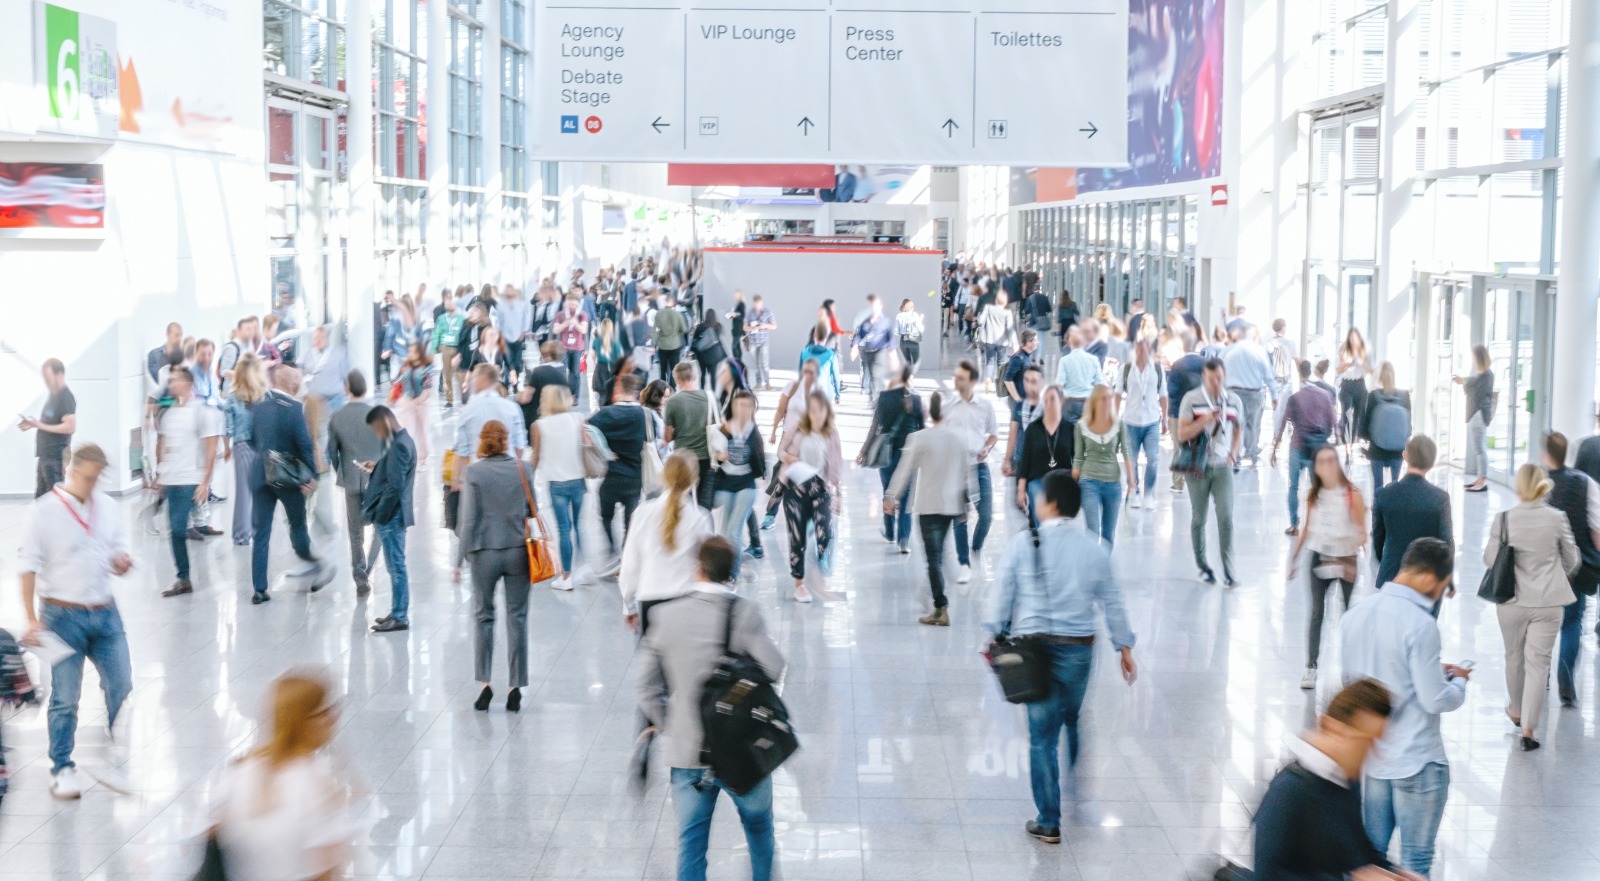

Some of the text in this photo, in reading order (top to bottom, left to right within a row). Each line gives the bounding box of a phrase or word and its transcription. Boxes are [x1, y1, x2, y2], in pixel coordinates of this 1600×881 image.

[561, 23, 624, 42] Agency
[701, 25, 796, 43] VIP Lounge
[846, 26, 895, 41] Press
[990, 31, 1063, 47] Toilettes
[561, 43, 625, 61] Lounge
[846, 46, 903, 61] Center
[57, 39, 79, 121] 6
[561, 69, 624, 84] Debate
[561, 89, 611, 107] Stage
[564, 120, 576, 129] AL
[702, 122, 716, 130] VIP
